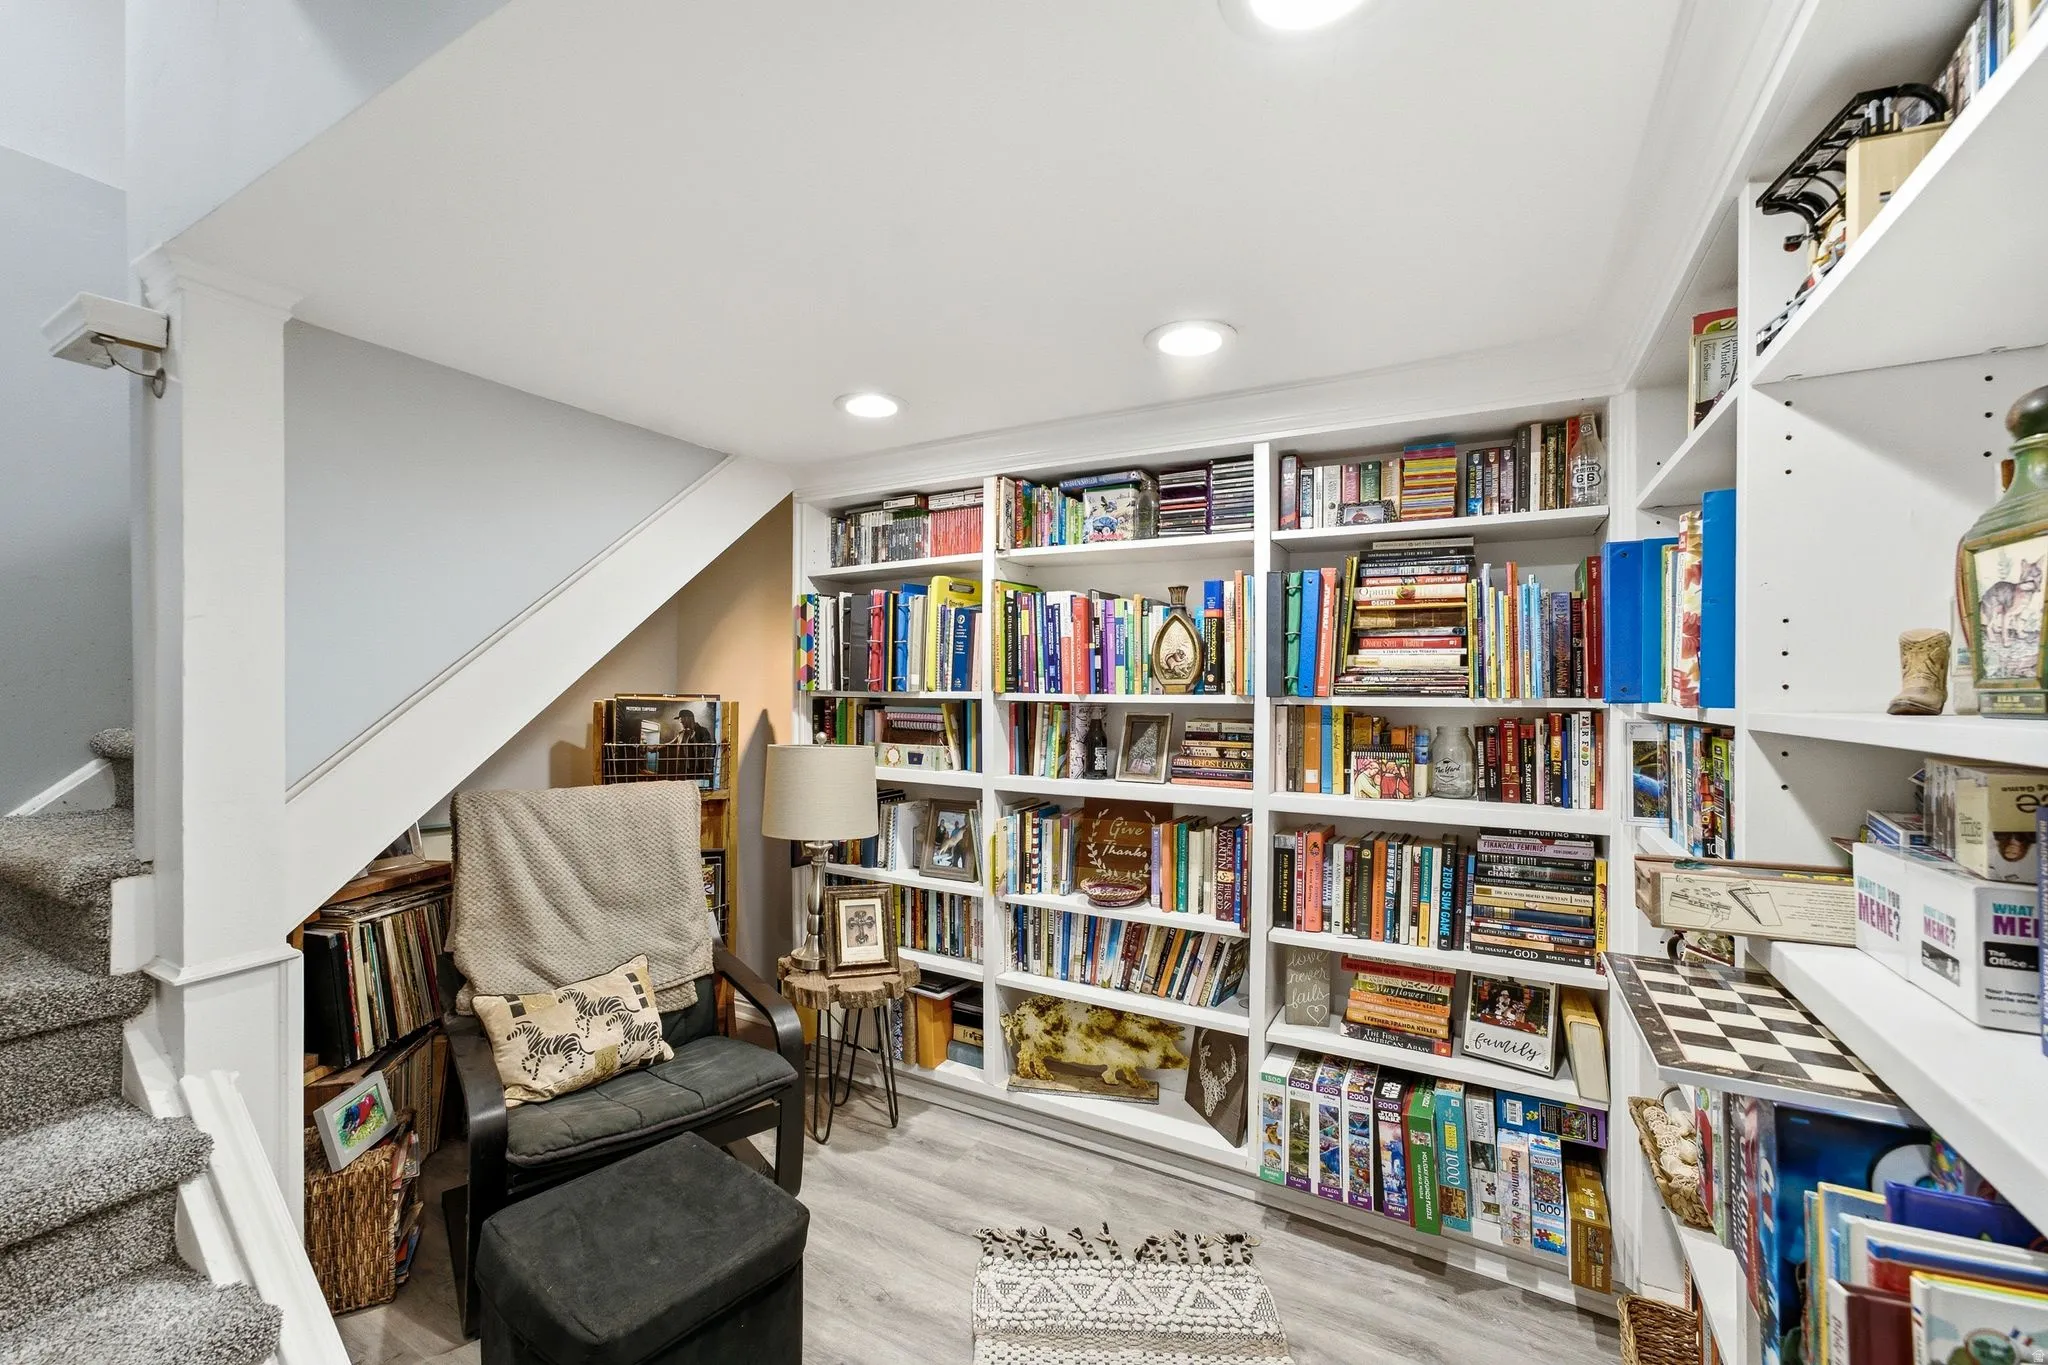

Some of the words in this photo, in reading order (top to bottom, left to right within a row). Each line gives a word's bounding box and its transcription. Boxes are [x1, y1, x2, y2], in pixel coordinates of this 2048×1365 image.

[1576, 472, 1597, 484] 66
[1359, 588, 1394, 597] Opium
[1581, 715, 1590, 737] FAIR
[1581, 741, 1590, 766] FOOD
[1193, 759, 1220, 768] GHOST
[1221, 761, 1246, 769] HAWK
[1444, 764, 1461, 774] Yard
[1553, 761, 1561, 775] SALE
[1524, 763, 1532, 802] SEABISCUIT
[1109, 817, 1144, 839] Give
[1528, 830, 1569, 838] HAUNTING
[1102, 839, 1147, 858] Thanks
[1217, 828, 1227, 869] MARTIN
[1483, 841, 1516, 850] FINANCIAL
[1516, 843, 1547, 852] FEMINIST
[1501, 856, 1515, 864] LAST
[1386, 869, 1393, 877] OF
[1442, 867, 1453, 889] ZERO
[1487, 869, 1519, 878] CHANCE
[1224, 884, 1232, 900] FIRE
[1386, 879, 1394, 895] PREY
[1856, 875, 1876, 897] WHAT
[1876, 882, 1886, 902] DO
[1887, 887, 1900, 910] YOU
[1216, 883, 1224, 910] BLOOD
[1441, 891, 1451, 910] SUM
[1992, 903, 2034, 916] WHAT
[1440, 911, 1451, 936] GAME
[1857, 893, 1901, 942] MEME?
[1923, 916, 1956, 949] MEME?
[1287, 950, 1331, 967] love
[1513, 949, 1539, 959] GOD
[1987, 949, 2006, 958] The
[1988, 956, 2027, 968] Office
[1286, 967, 1330, 985] never
[1286, 983, 1330, 1009] fails
[1376, 984, 1426, 999] Mayflower
[1366, 1028, 1381, 1037] THE
[1382, 1031, 1400, 1042] FIRST
[1362, 1034, 1404, 1049] AMERICAN
[1406, 1043, 1430, 1053] ARMY
[1473, 1032, 1542, 1061] family
[1290, 1081, 1310, 1090] 2000
[1319, 1086, 1339, 1096] 2000
[1349, 1093, 1369, 1102] 2000
[1377, 1102, 1399, 1111] 2000
[1379, 1110, 1399, 1118] STAR
[1377, 1115, 1401, 1123] WARS
[1445, 1152, 1460, 1186] 1000
[1421, 1151, 1429, 1176] HOLIDAY
[1425, 1200, 1433, 1220] PUZZLE
[1534, 1201, 1563, 1216] 1000
[1511, 1211, 1523, 1245] Puzzle
